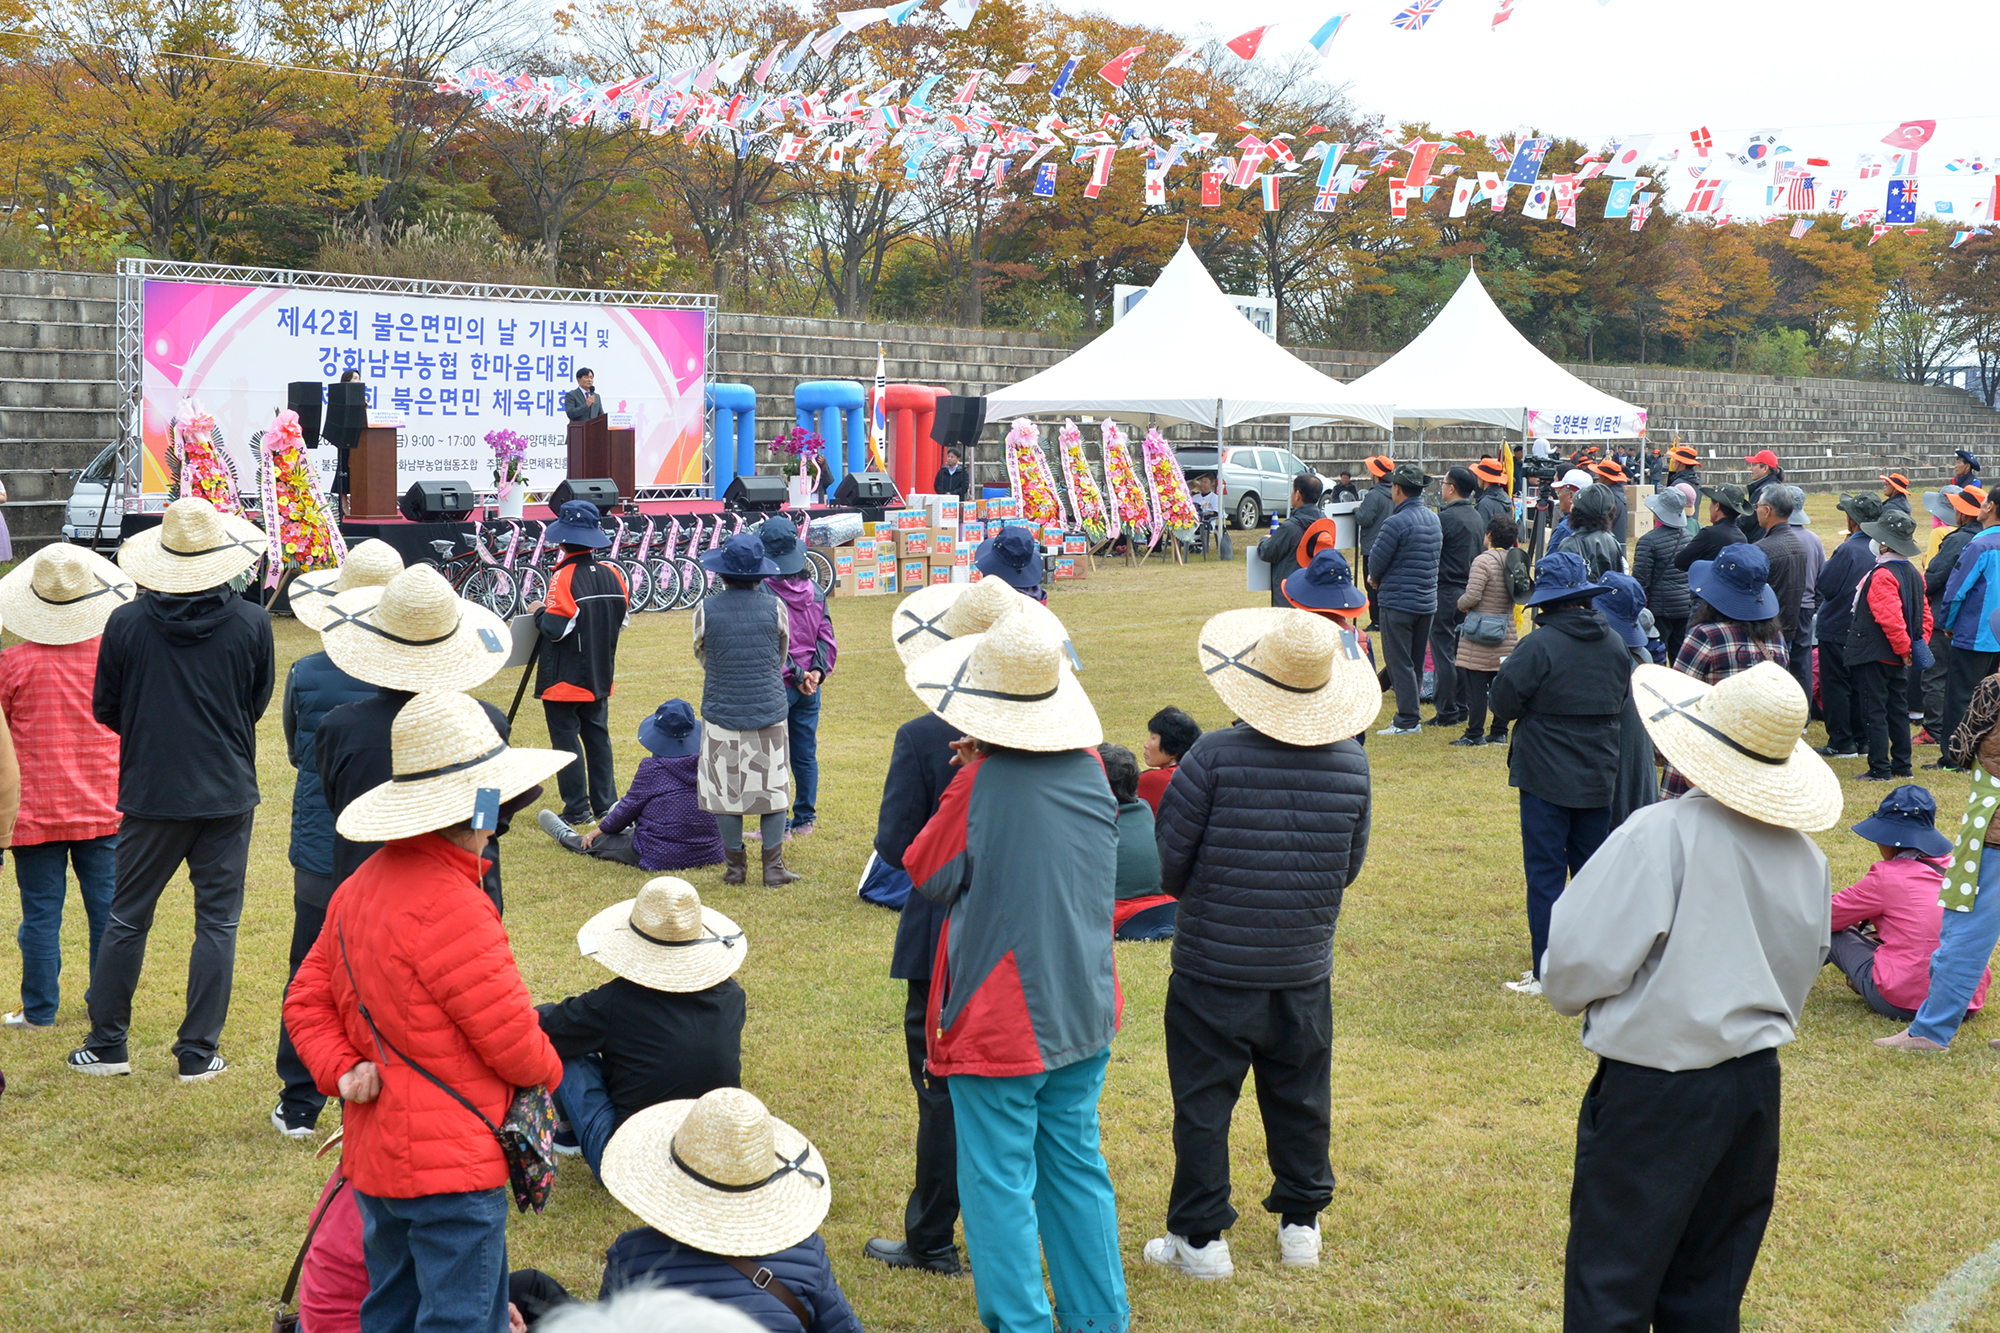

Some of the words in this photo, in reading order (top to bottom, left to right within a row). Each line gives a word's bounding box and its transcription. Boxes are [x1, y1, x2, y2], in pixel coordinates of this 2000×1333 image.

[277, 306, 358, 341] 제42회
[371, 312, 485, 346] 불은면민의
[498, 318, 517, 346] 날
[528, 319, 588, 348] 기념식
[596, 329, 609, 348] 및
[318, 346, 458, 381] 강화남부농협
[470, 352, 574, 382] 한마음대회
[391, 386, 480, 416] 불은면민
[1594, 415, 1621, 434] 의료진
[411, 434, 435, 447] 9:00
[447, 434, 476, 447] 17:00
[321, 458, 338, 472] 불은
[397, 458, 478, 472] 화남부농업협동조합
[522, 457, 567, 470] 은면체육진흥
